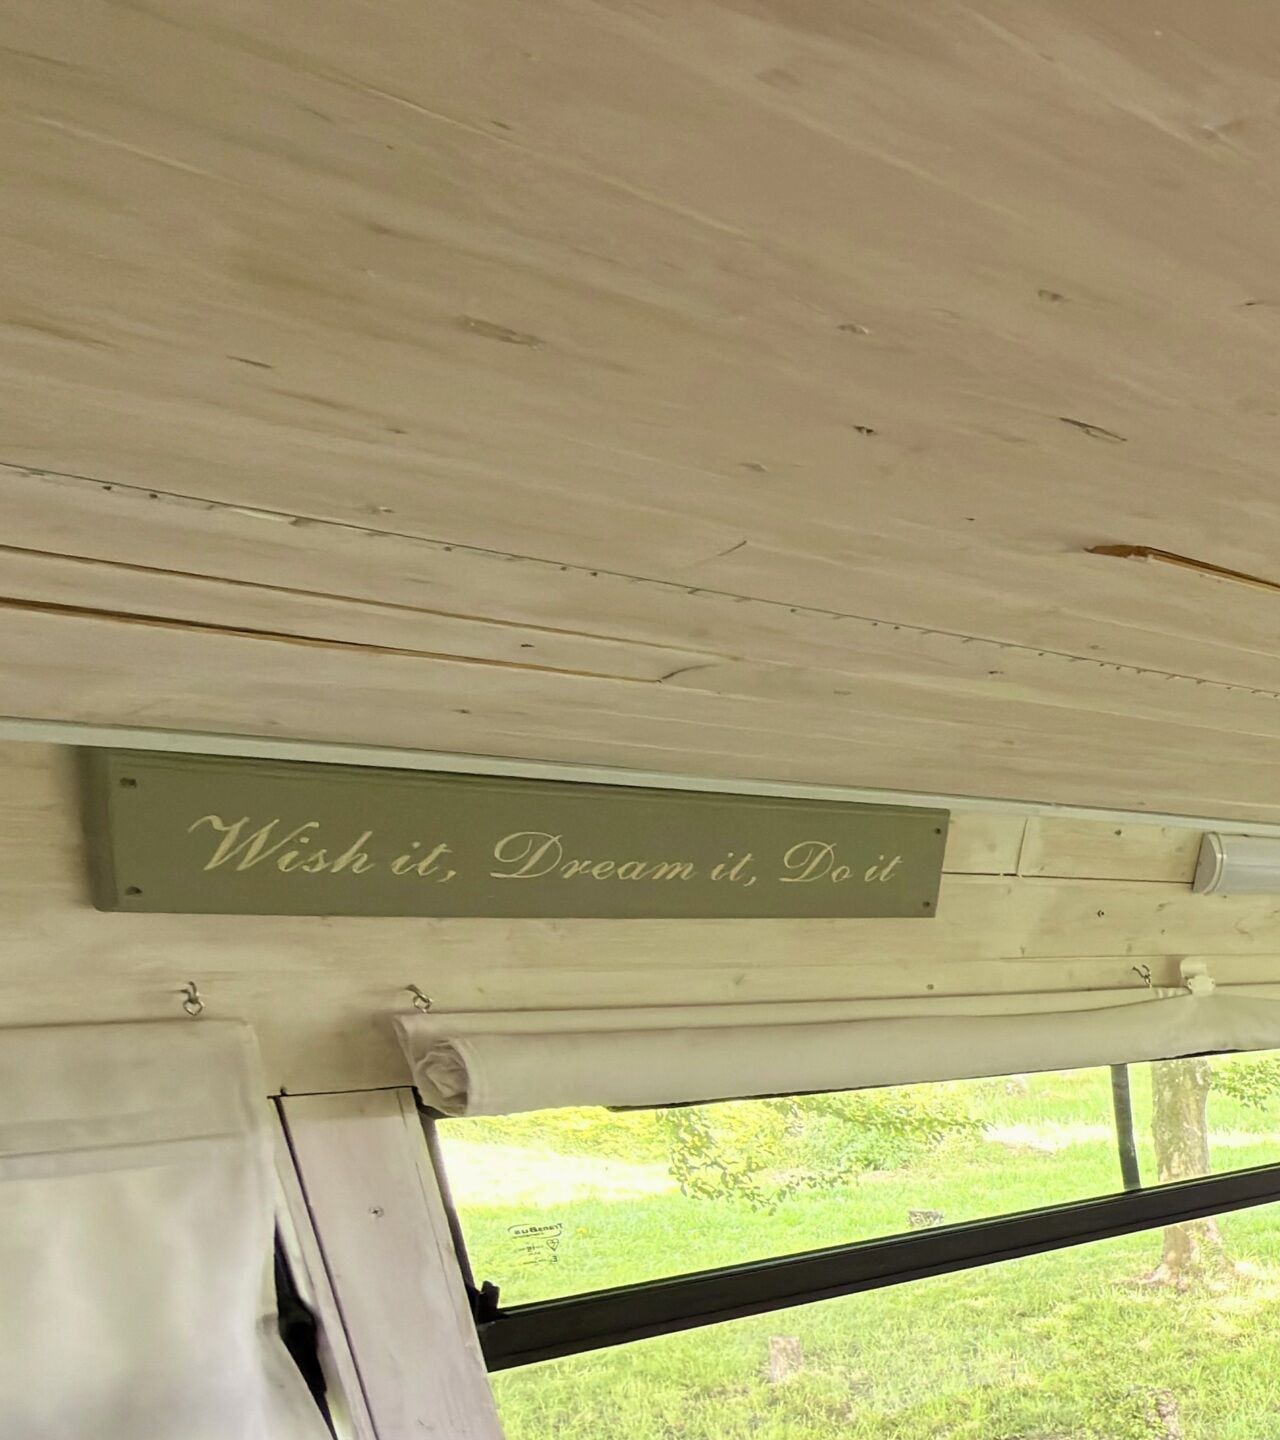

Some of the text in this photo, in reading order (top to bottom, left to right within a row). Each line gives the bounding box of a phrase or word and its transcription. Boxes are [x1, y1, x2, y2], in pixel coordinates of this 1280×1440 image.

[188, 814, 903, 887] Wish it, Dream it, Do it
